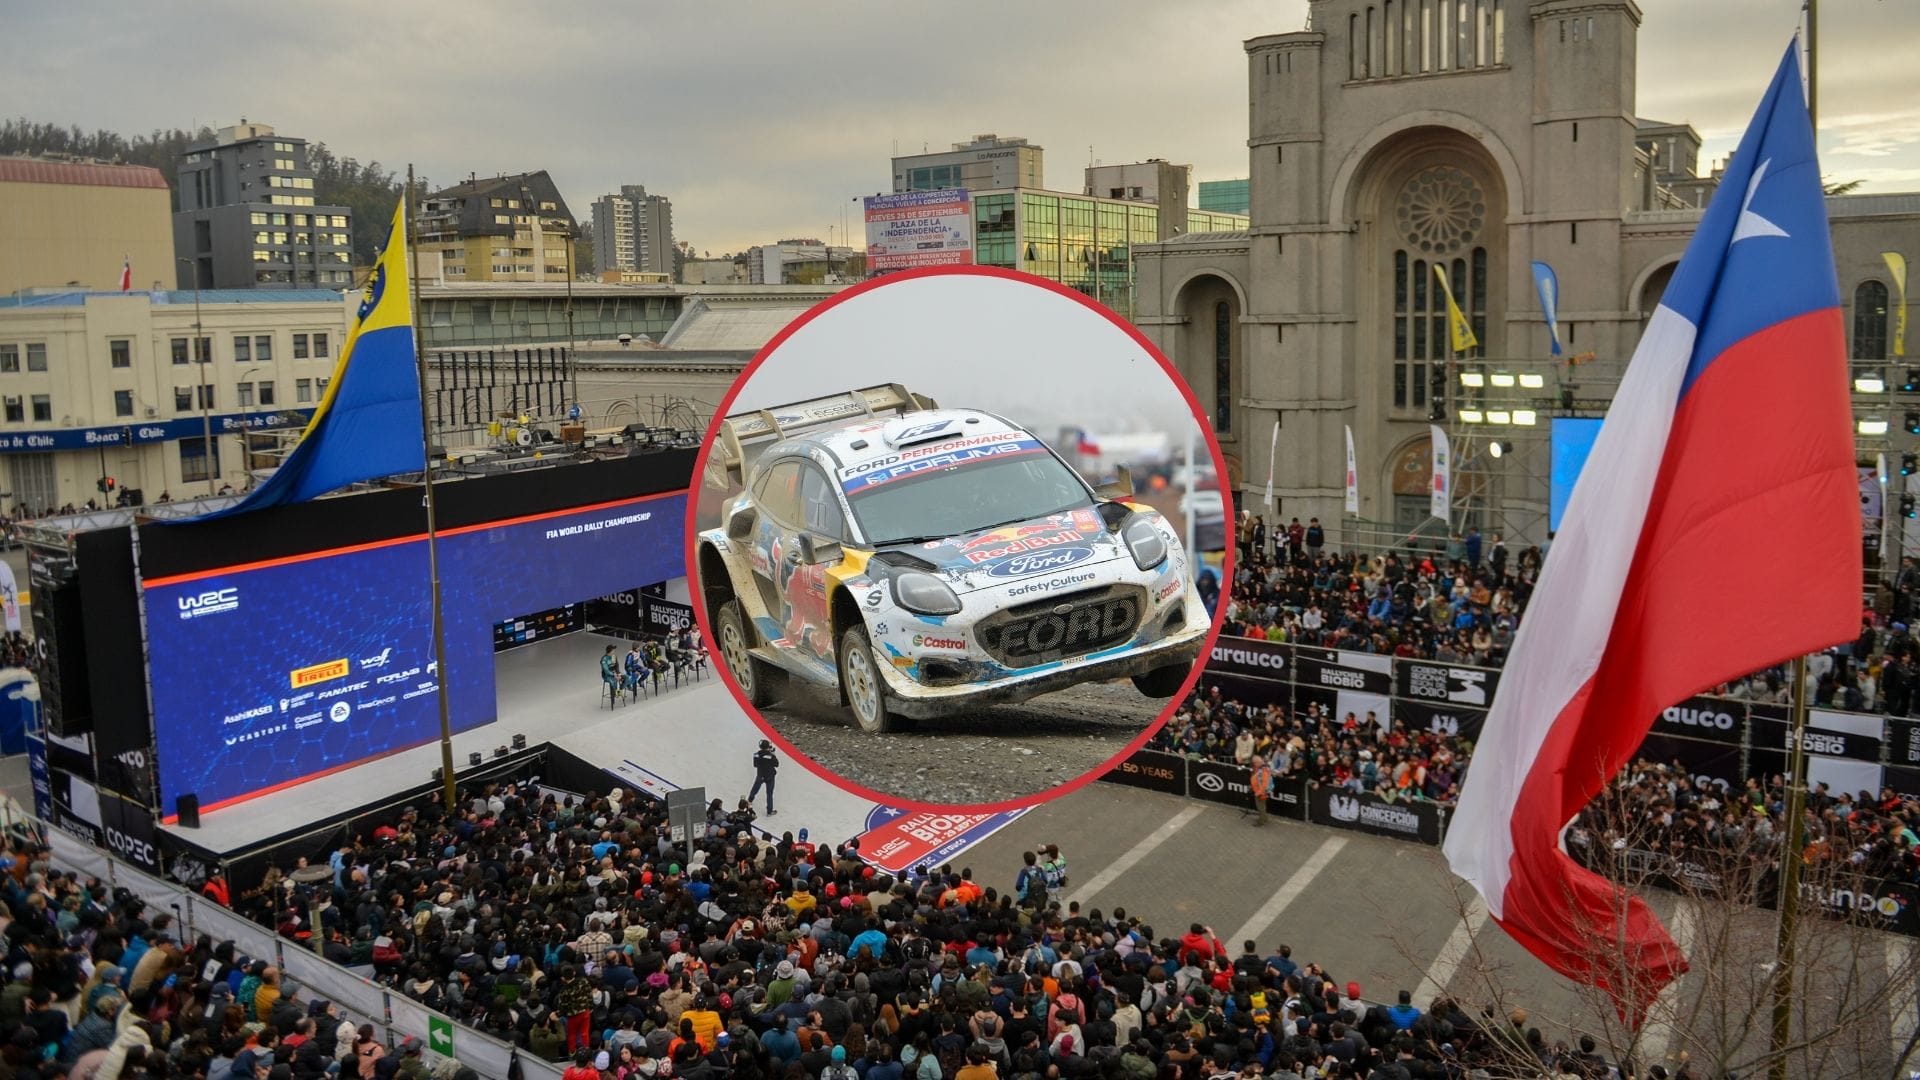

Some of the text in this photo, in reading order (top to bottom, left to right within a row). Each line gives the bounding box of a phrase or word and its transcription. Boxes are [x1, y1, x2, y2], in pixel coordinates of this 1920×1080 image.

[869, 213, 895, 221] JUEVES
[918, 208, 963, 218] SEPTIEMBRE
[891, 218, 941, 228] PLAZA DE LA
[885, 226, 947, 237] INDEPENDENCIA
[875, 257, 960, 269] PROTOCOLAR INOLVIDABLE
[27, 434, 54, 447] Chile
[85, 430, 119, 443] Banco
[139, 427, 165, 439] Chile
[845, 432, 1023, 477] FORD PERFORMANCE
[892, 443, 1021, 477] FORUM8
[546, 512, 651, 539] FIA WORLD RALLY CHAMPIONSHIP
[966, 530, 1084, 564] Red Bull
[1009, 550, 1074, 576] Ford
[178, 587, 239, 610] WRC
[1160, 578, 1181, 600] Castrol
[1000, 599, 1135, 657] FORD
[923, 636, 966, 650] Castrol
[1211, 645, 1284, 669] arauco
[297, 663, 343, 684] PIRELLI
[1321, 667, 1365, 680] RALLYCHILE
[318, 681, 370, 700] FANATEC
[1663, 706, 1733, 730] auco
[239, 723, 288, 742] CASTORE
[1141, 765, 1175, 780] YEARS
[1360, 804, 1419, 829] CONCEPCIÓN
[106, 826, 155, 866] COPEC
[939, 838, 967, 856] arauco
